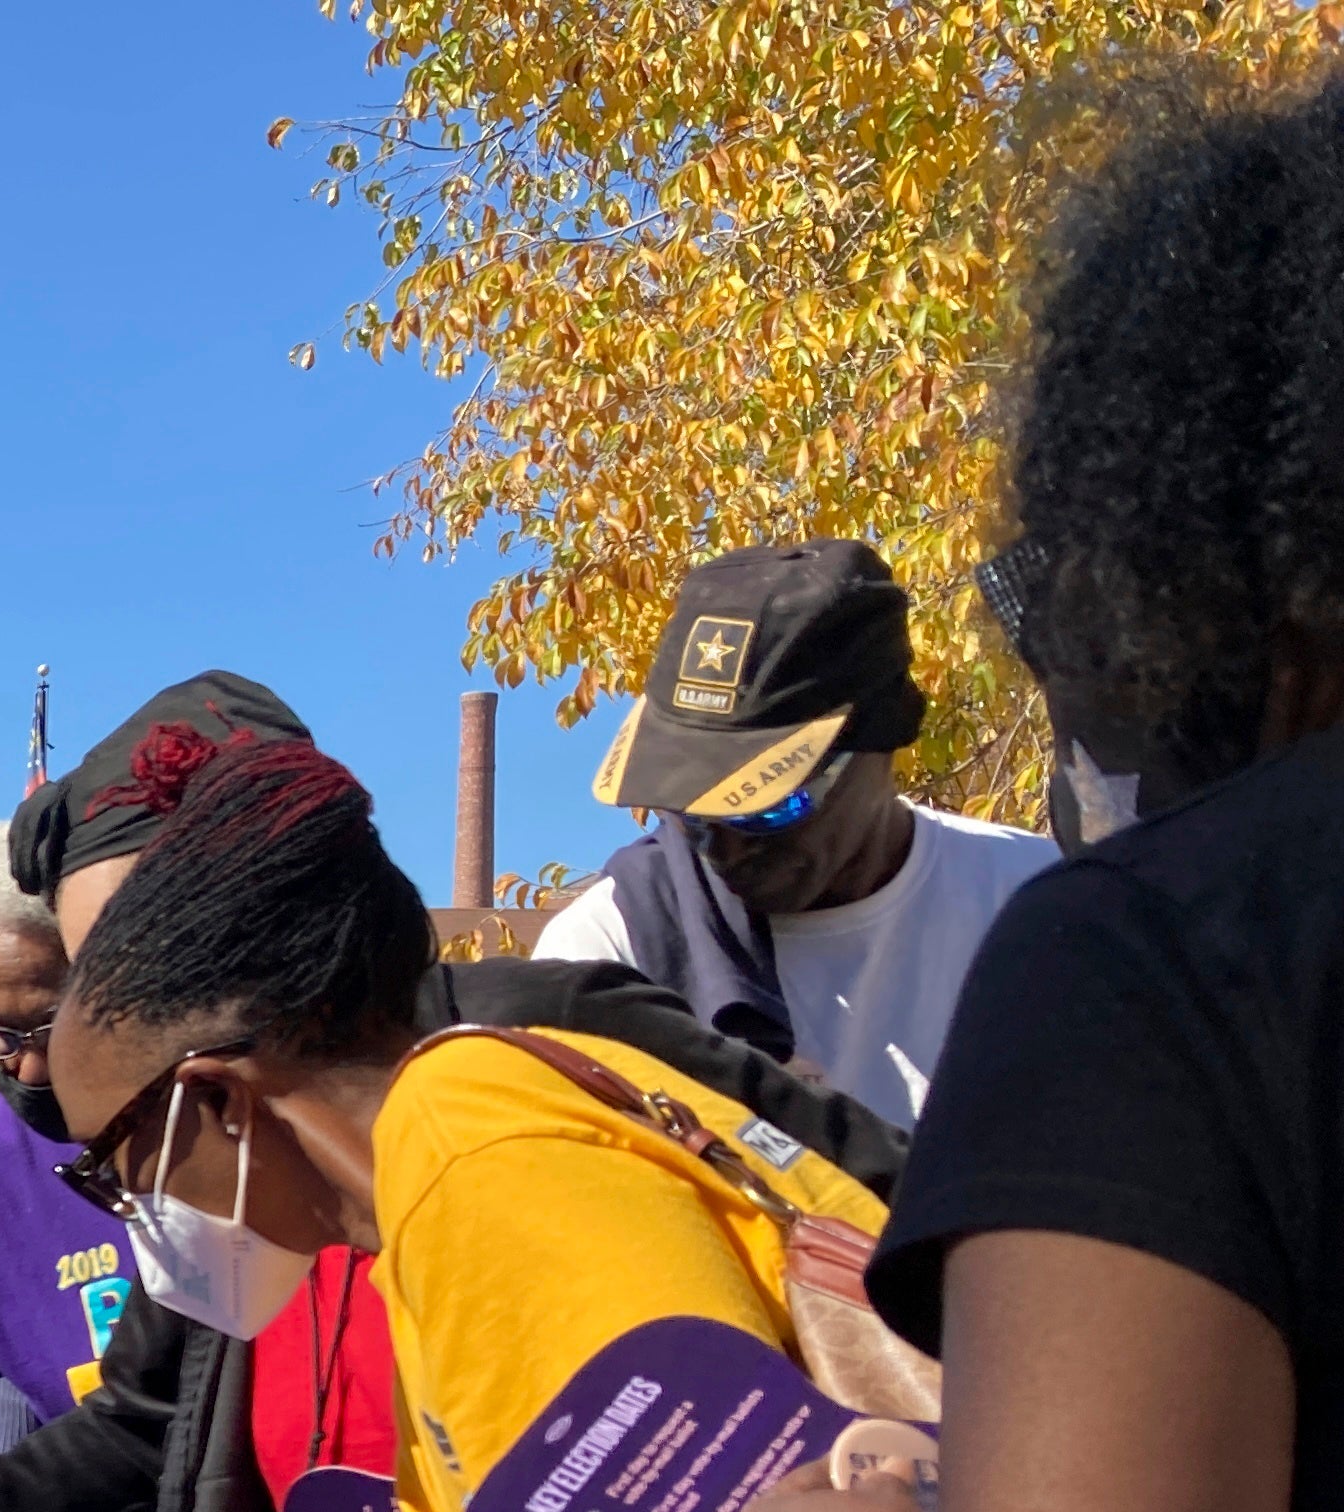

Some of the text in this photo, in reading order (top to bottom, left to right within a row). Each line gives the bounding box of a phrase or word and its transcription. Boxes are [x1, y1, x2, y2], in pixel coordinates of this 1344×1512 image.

[55, 1242, 120, 1291] 2019
[549, 1416, 625, 1490] ELECTION
[604, 1376, 662, 1427] DATES
